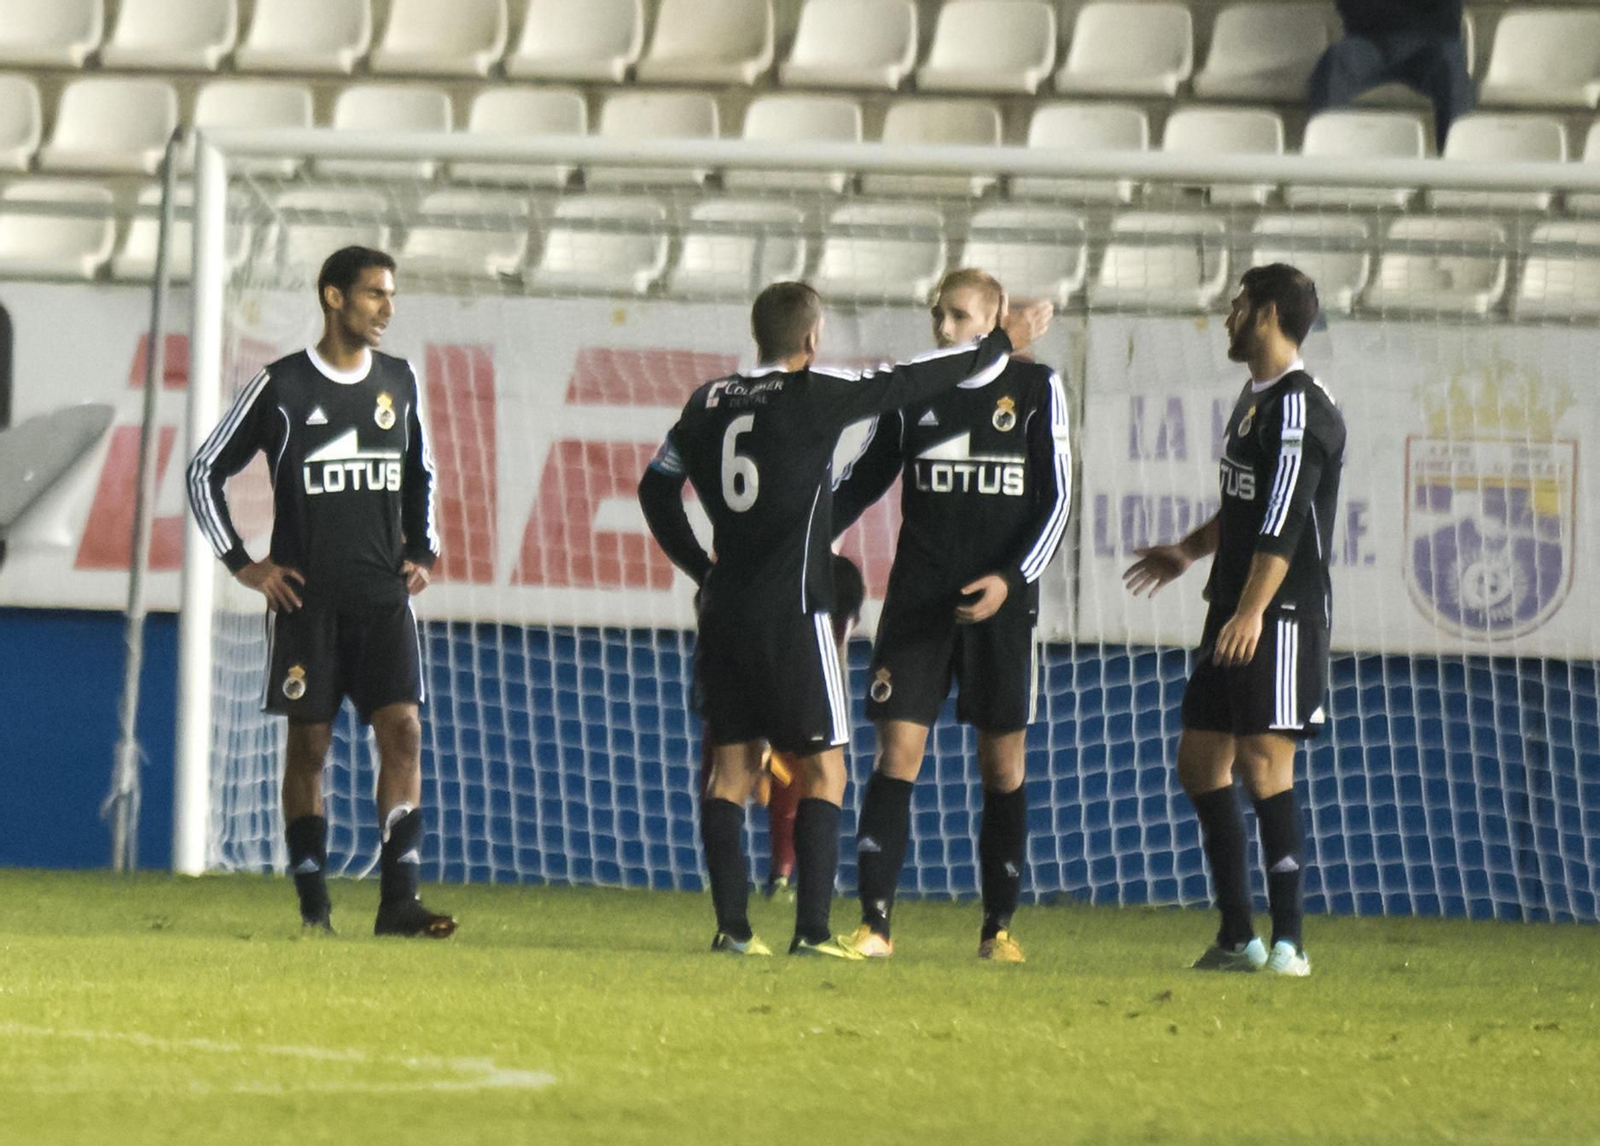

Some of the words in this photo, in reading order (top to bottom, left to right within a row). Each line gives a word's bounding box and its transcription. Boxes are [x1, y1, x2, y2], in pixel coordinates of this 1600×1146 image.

[303, 462, 401, 495] LOTUS
[721, 413, 760, 513] 6
[914, 462, 1025, 496] LOTUS
